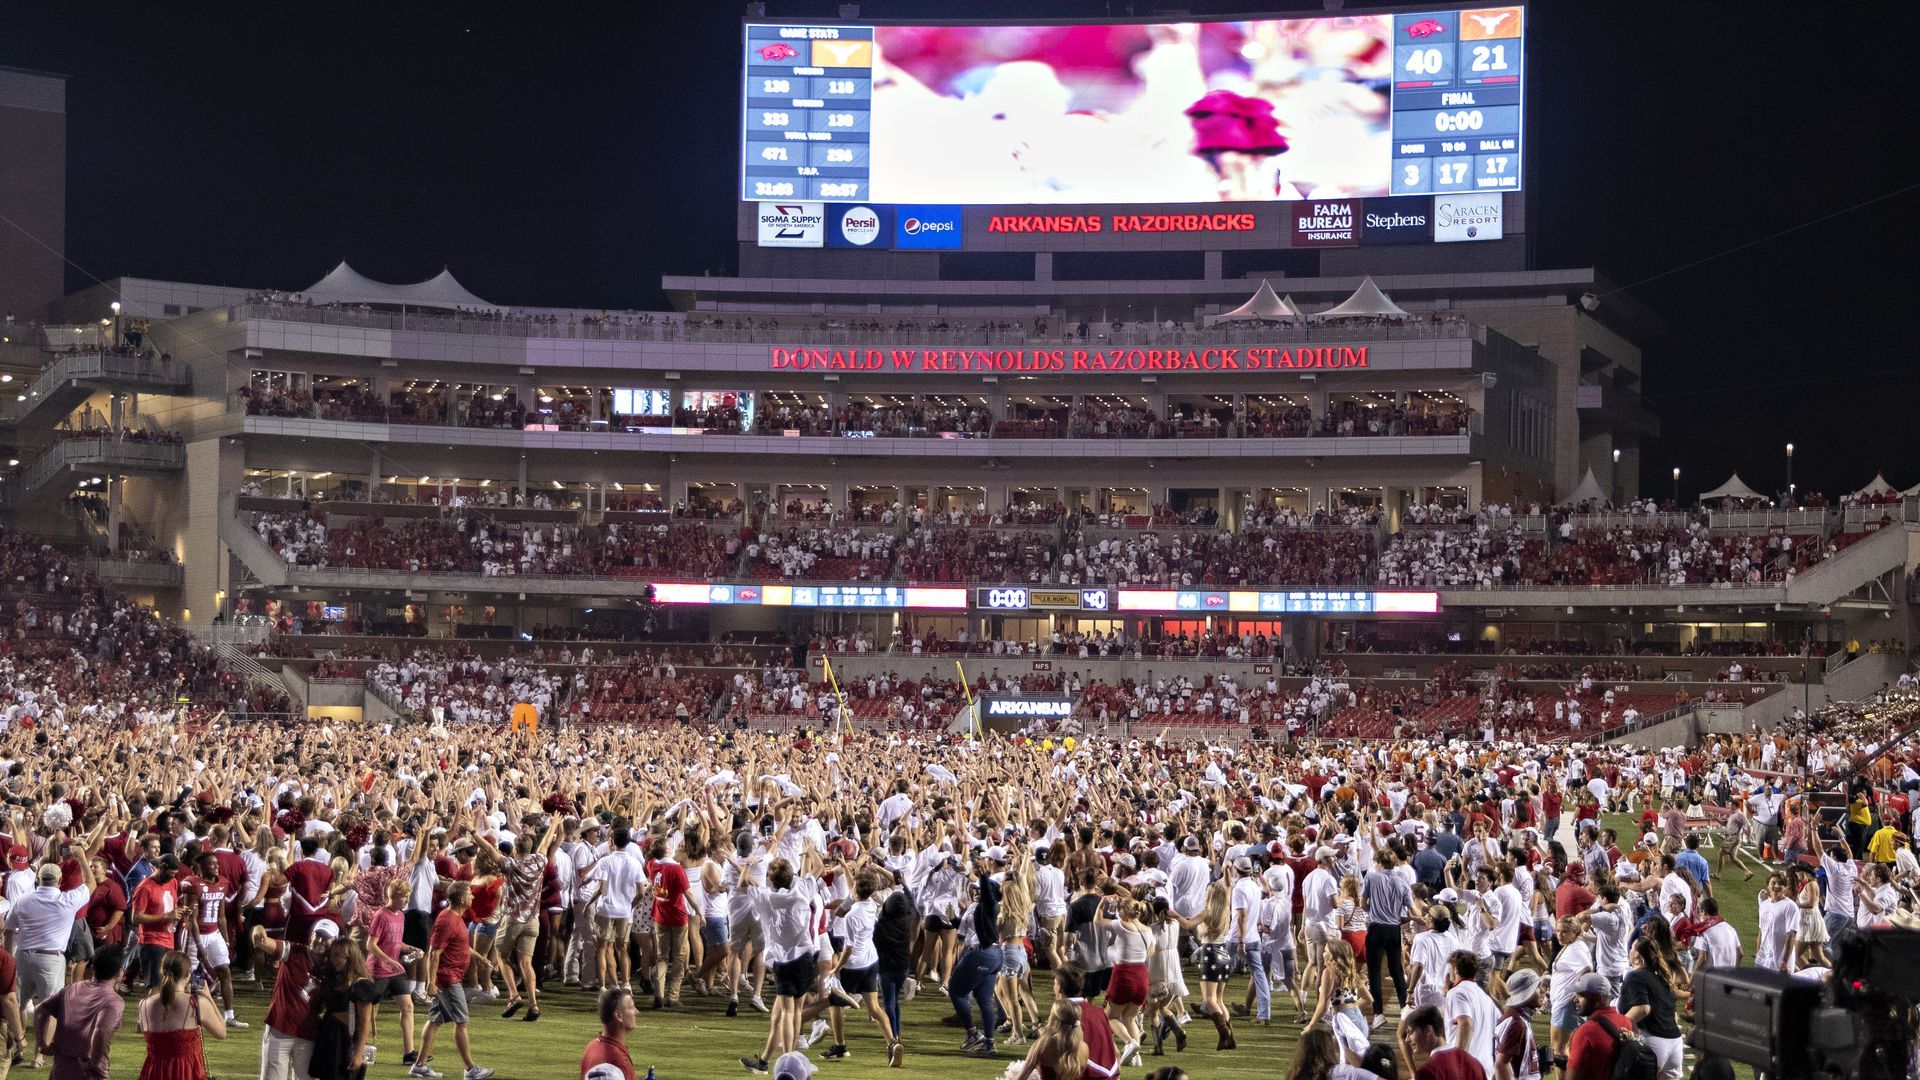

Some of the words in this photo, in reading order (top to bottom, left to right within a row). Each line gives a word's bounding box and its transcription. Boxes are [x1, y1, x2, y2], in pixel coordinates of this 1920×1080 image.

[809, 28, 839, 40] STATS
[1406, 49, 1442, 74] 40
[1472, 45, 1508, 71] 21
[1442, 92, 1476, 106] FINAL
[1435, 110, 1484, 132] 0:00
[1400, 144, 1426, 154] DOWN
[1442, 142, 1454, 152] TO
[1454, 142, 1466, 152] GO
[1480, 140, 1501, 150] BALL
[762, 148, 788, 160] 471
[1486, 157, 1508, 174] 17
[1404, 165, 1420, 186] 3
[1440, 162, 1468, 184] 17
[1314, 204, 1352, 216] FARM
[1439, 204, 1498, 228] SARACEN
[761, 215, 789, 223] SIGMA
[846, 217, 876, 228] Persil
[922, 220, 954, 232] pepsi
[988, 216, 1102, 232] ARKANSAS
[1112, 214, 1255, 232] RAZORBACKS
[1298, 216, 1352, 229] BUREAU
[1366, 212, 1426, 230] Stephens
[1453, 216, 1498, 225] RESORT
[1308, 232, 1352, 240] INSURANCE
[772, 348, 884, 370] DONALD
[890, 350, 915, 370] W
[922, 350, 1065, 370] REYNOLDS
[1072, 349, 1240, 370] RAZORBACK
[1246, 346, 1368, 368] STADIUM
[795, 590, 813, 603] 21
[989, 589, 1026, 608] 0:00
[1084, 590, 1106, 609] 40
[990, 701, 1071, 714] ARKANSAS
[1414, 825, 1424, 843] 5
[204, 900, 220, 922] 11
